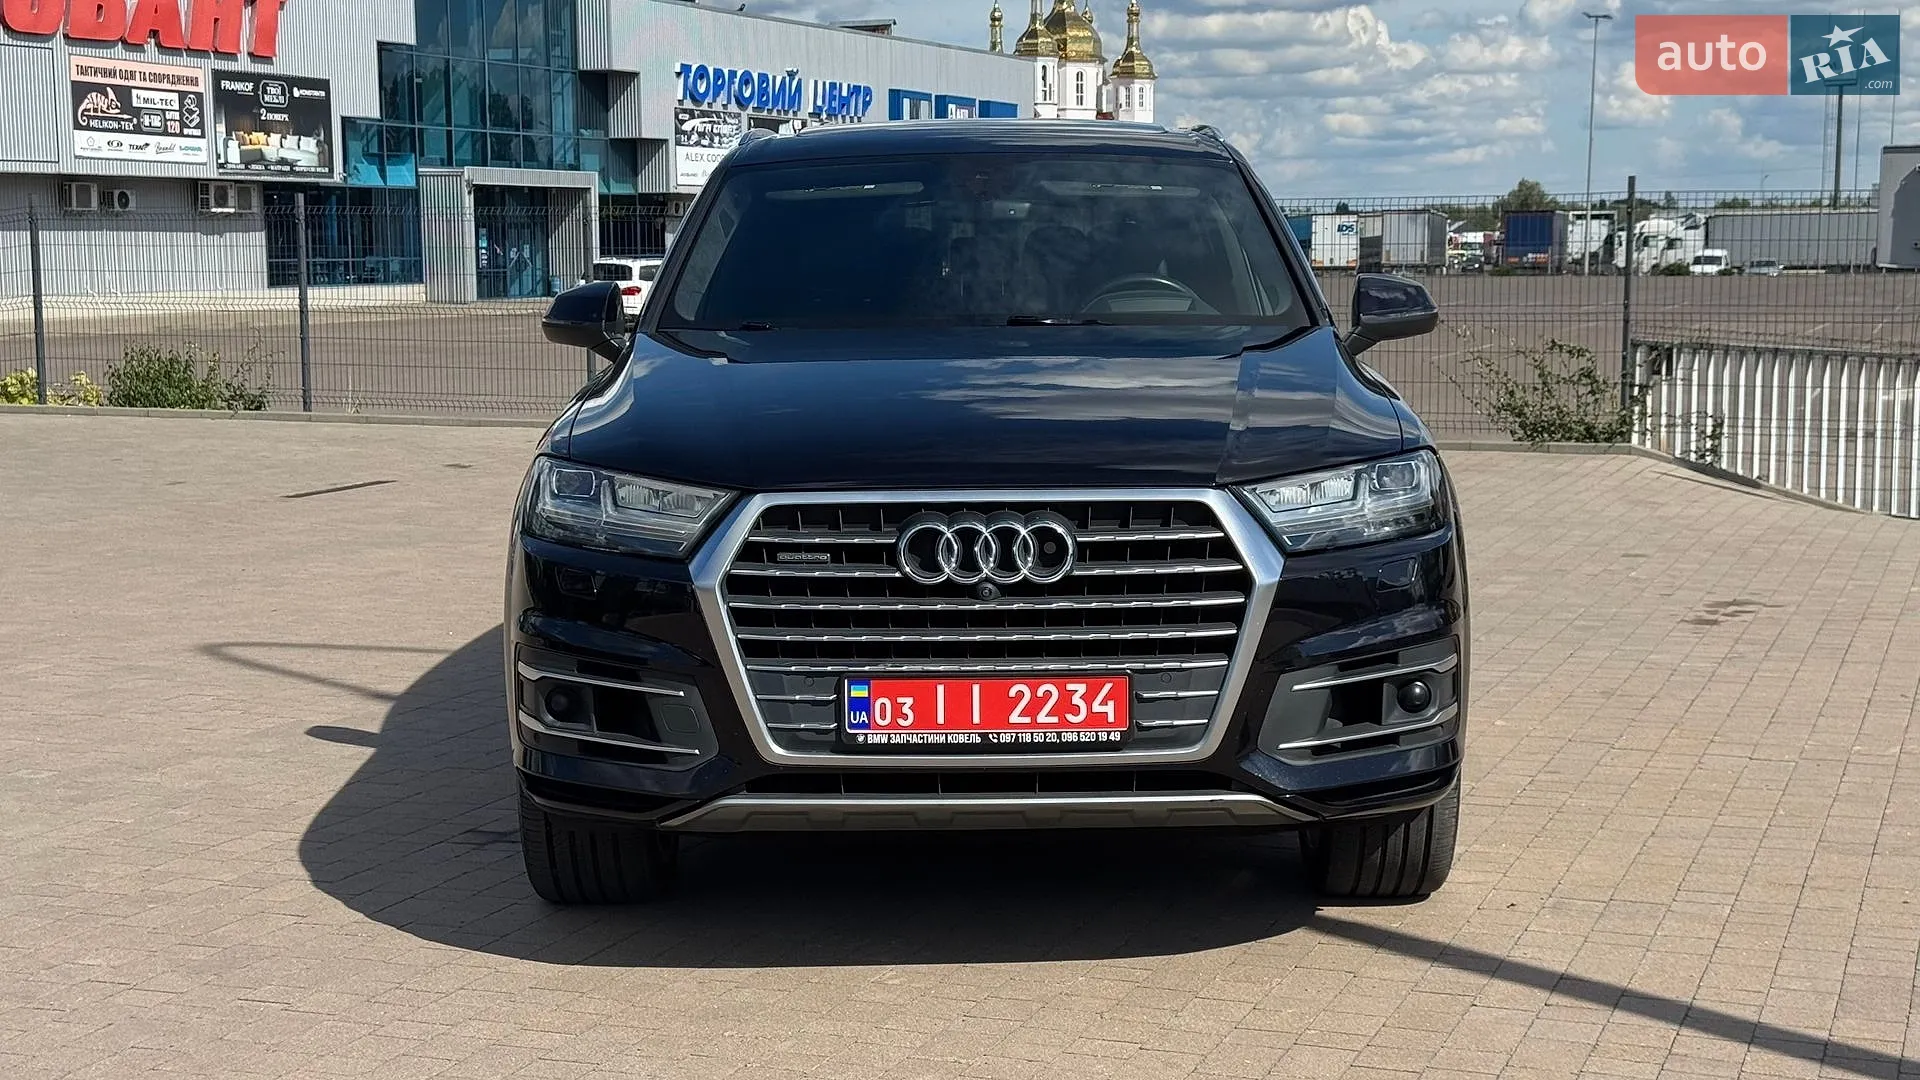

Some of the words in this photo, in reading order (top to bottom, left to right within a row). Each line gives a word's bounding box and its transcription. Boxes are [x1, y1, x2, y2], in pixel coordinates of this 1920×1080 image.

[75, 64, 117, 80] ТАКТИЧНИЙ
[139, 71, 147, 82] ТА
[221, 80, 254, 92] FRANKOF
[675, 62, 802, 112] ТОРГОВИЙ
[808, 79, 873, 118] ЦЕНТР
[89, 118, 134, 131] HELIKON-TEX
[874, 697, 914, 726] 03
[1008, 683, 1115, 724] 2234
[850, 710, 868, 724] UA
[867, 733, 888, 744] BMW
[890, 733, 946, 744] ЗАПЧАСТИНИ
[947, 733, 981, 744] КОВЕЛЬ
[1000, 733, 1017, 744] 097
[1018, 733, 1031, 744] 118
[1033, 733, 1044, 743] 50
[1046, 733, 1059, 745] 20,
[1061, 732, 1078, 743] 096
[1080, 732, 1097, 743] 520
[1098, 732, 1108, 743] 19
[1109, 732, 1121, 743] 49
